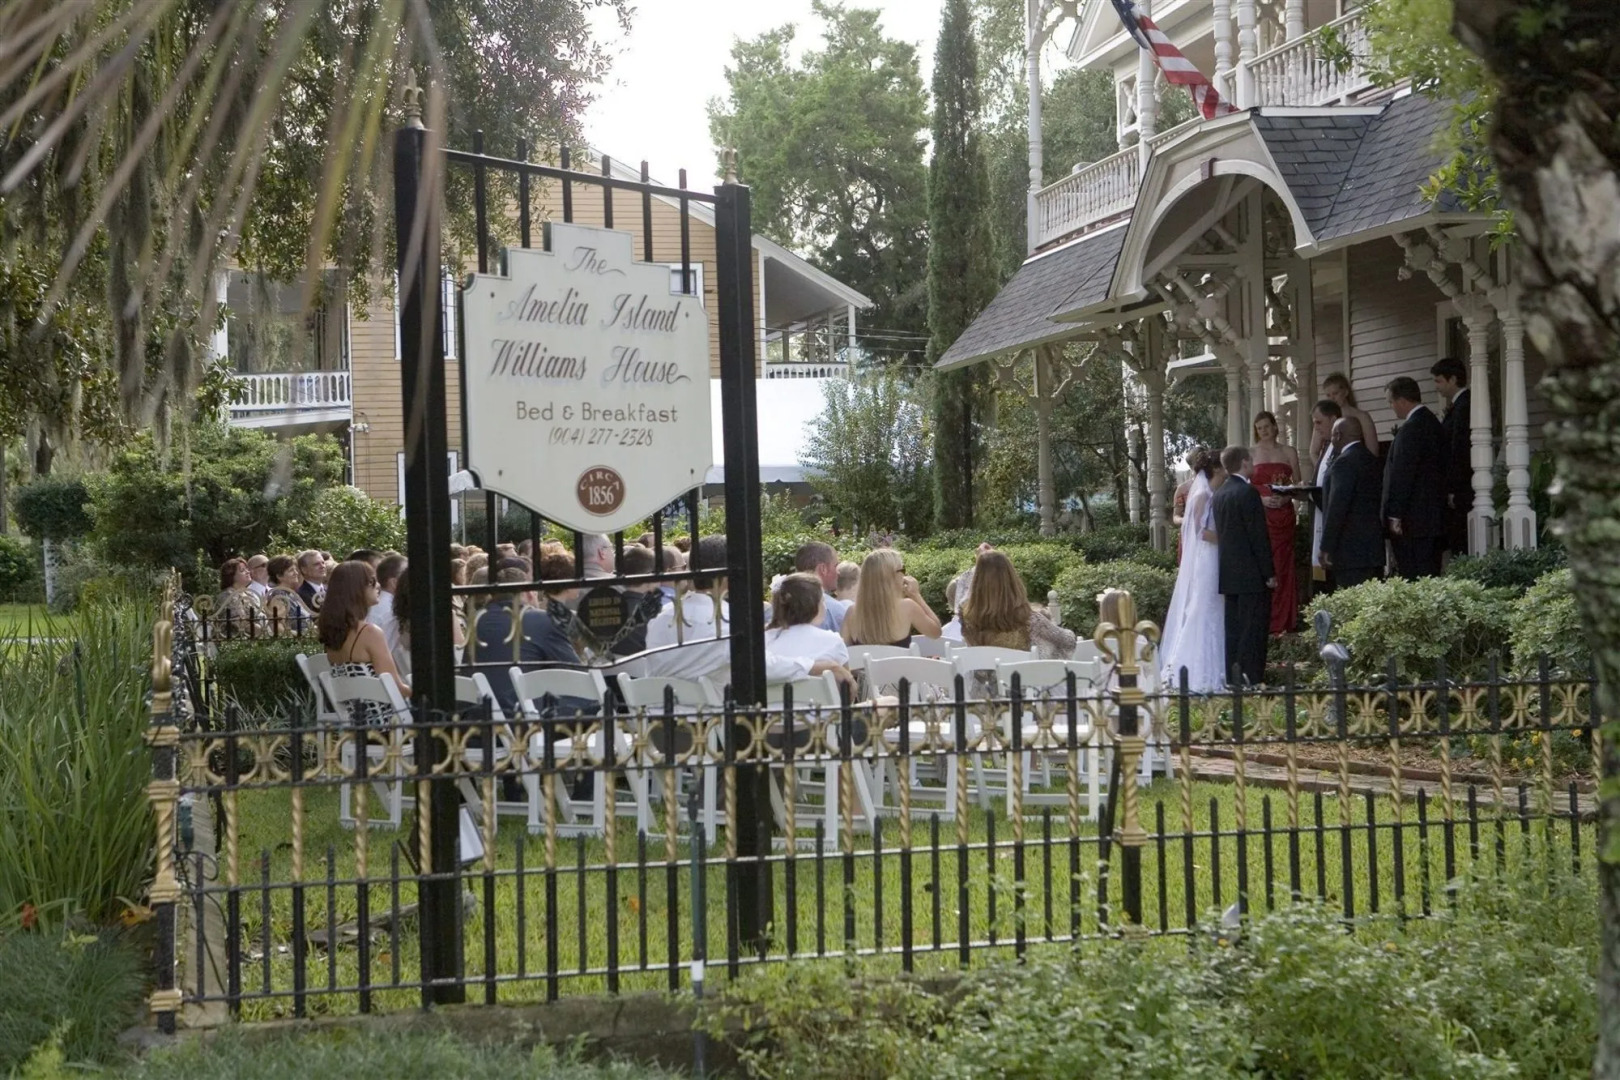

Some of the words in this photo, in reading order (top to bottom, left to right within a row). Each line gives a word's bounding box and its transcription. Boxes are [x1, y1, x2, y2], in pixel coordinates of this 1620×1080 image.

[563, 246, 626, 276] The
[501, 283, 589, 326] Amelia
[601, 293, 681, 333] Island
[491, 338, 587, 381] Williams
[604, 345, 691, 385] House
[516, 401, 553, 420] Bed
[562, 405, 574, 420] &
[582, 402, 678, 422] Breakfast
[579, 471, 621, 491] CIRCA
[588, 485, 614, 506] 1856
